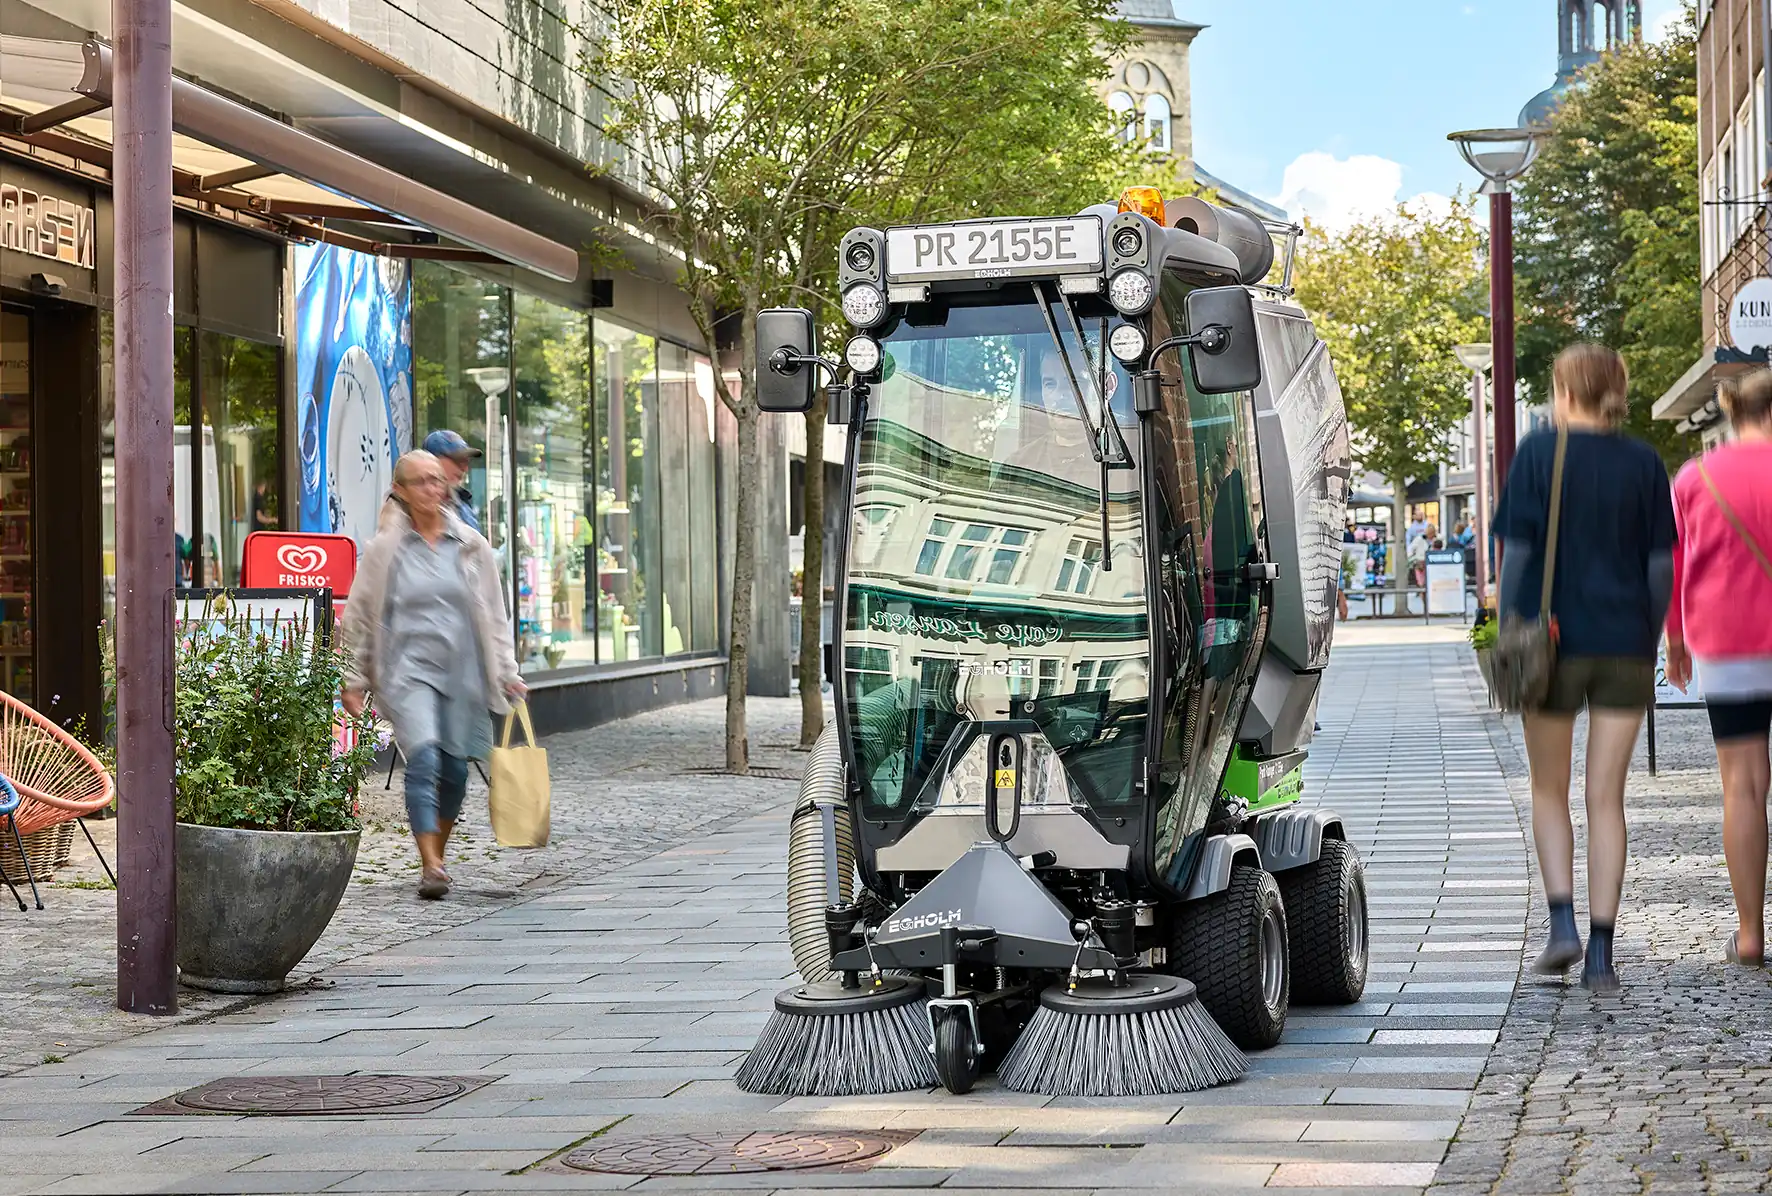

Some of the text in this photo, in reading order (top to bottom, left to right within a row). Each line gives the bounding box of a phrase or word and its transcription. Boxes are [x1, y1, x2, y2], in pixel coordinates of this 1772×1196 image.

[913, 225, 1077, 267] PR 2155E
[278, 573, 326, 587] FRISKO
[958, 661, 1032, 676] EGHOLM
[888, 908, 962, 934] EGHOLM
